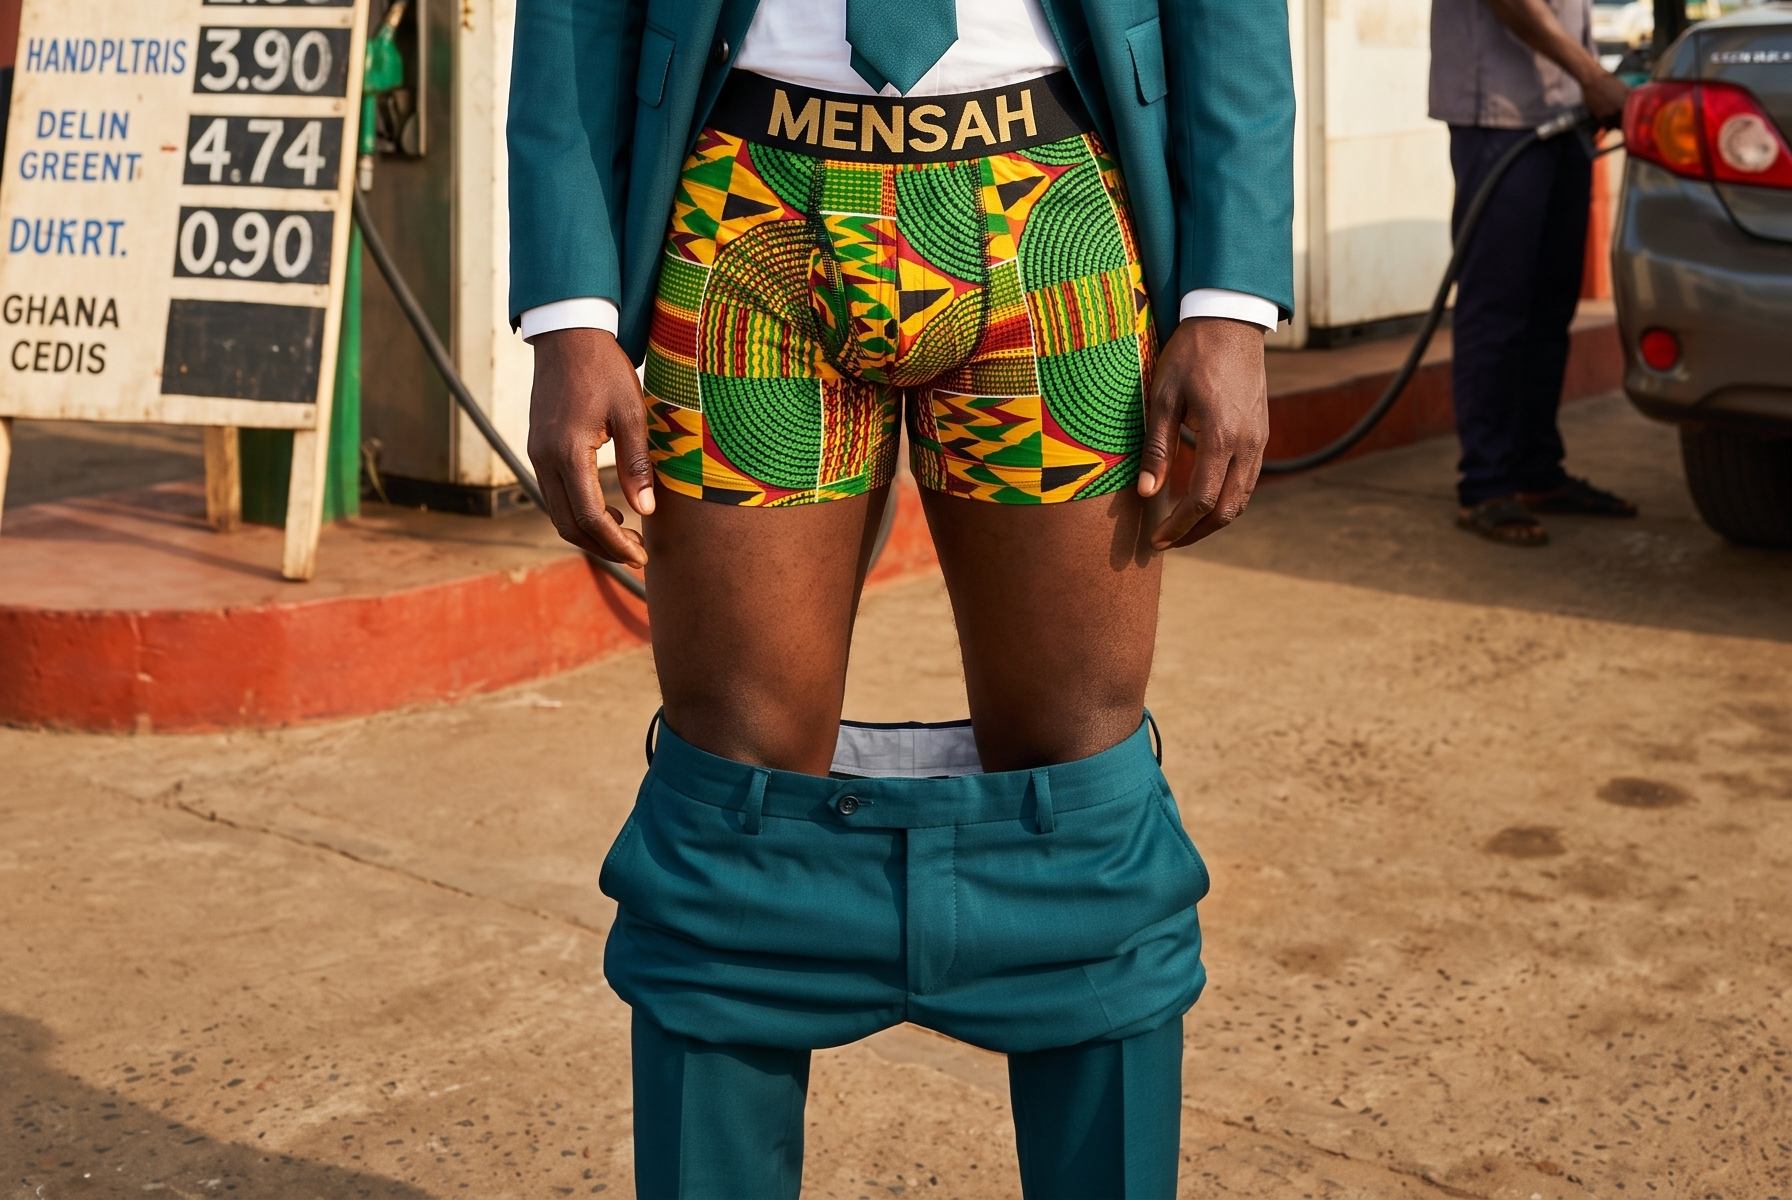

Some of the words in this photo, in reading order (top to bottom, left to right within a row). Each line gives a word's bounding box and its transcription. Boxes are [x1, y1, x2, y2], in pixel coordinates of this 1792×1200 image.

[200, 28, 333, 93] 3.90
[19, 152, 142, 182] GREENT
[188, 117, 326, 187] 4.74
[36, 110, 130, 140] DELIN
[767, 88, 1038, 154] MENSAH
[179, 210, 314, 278] 0.90
[2, 294, 120, 329] GHANA
[11, 341, 106, 374] CEDIS
